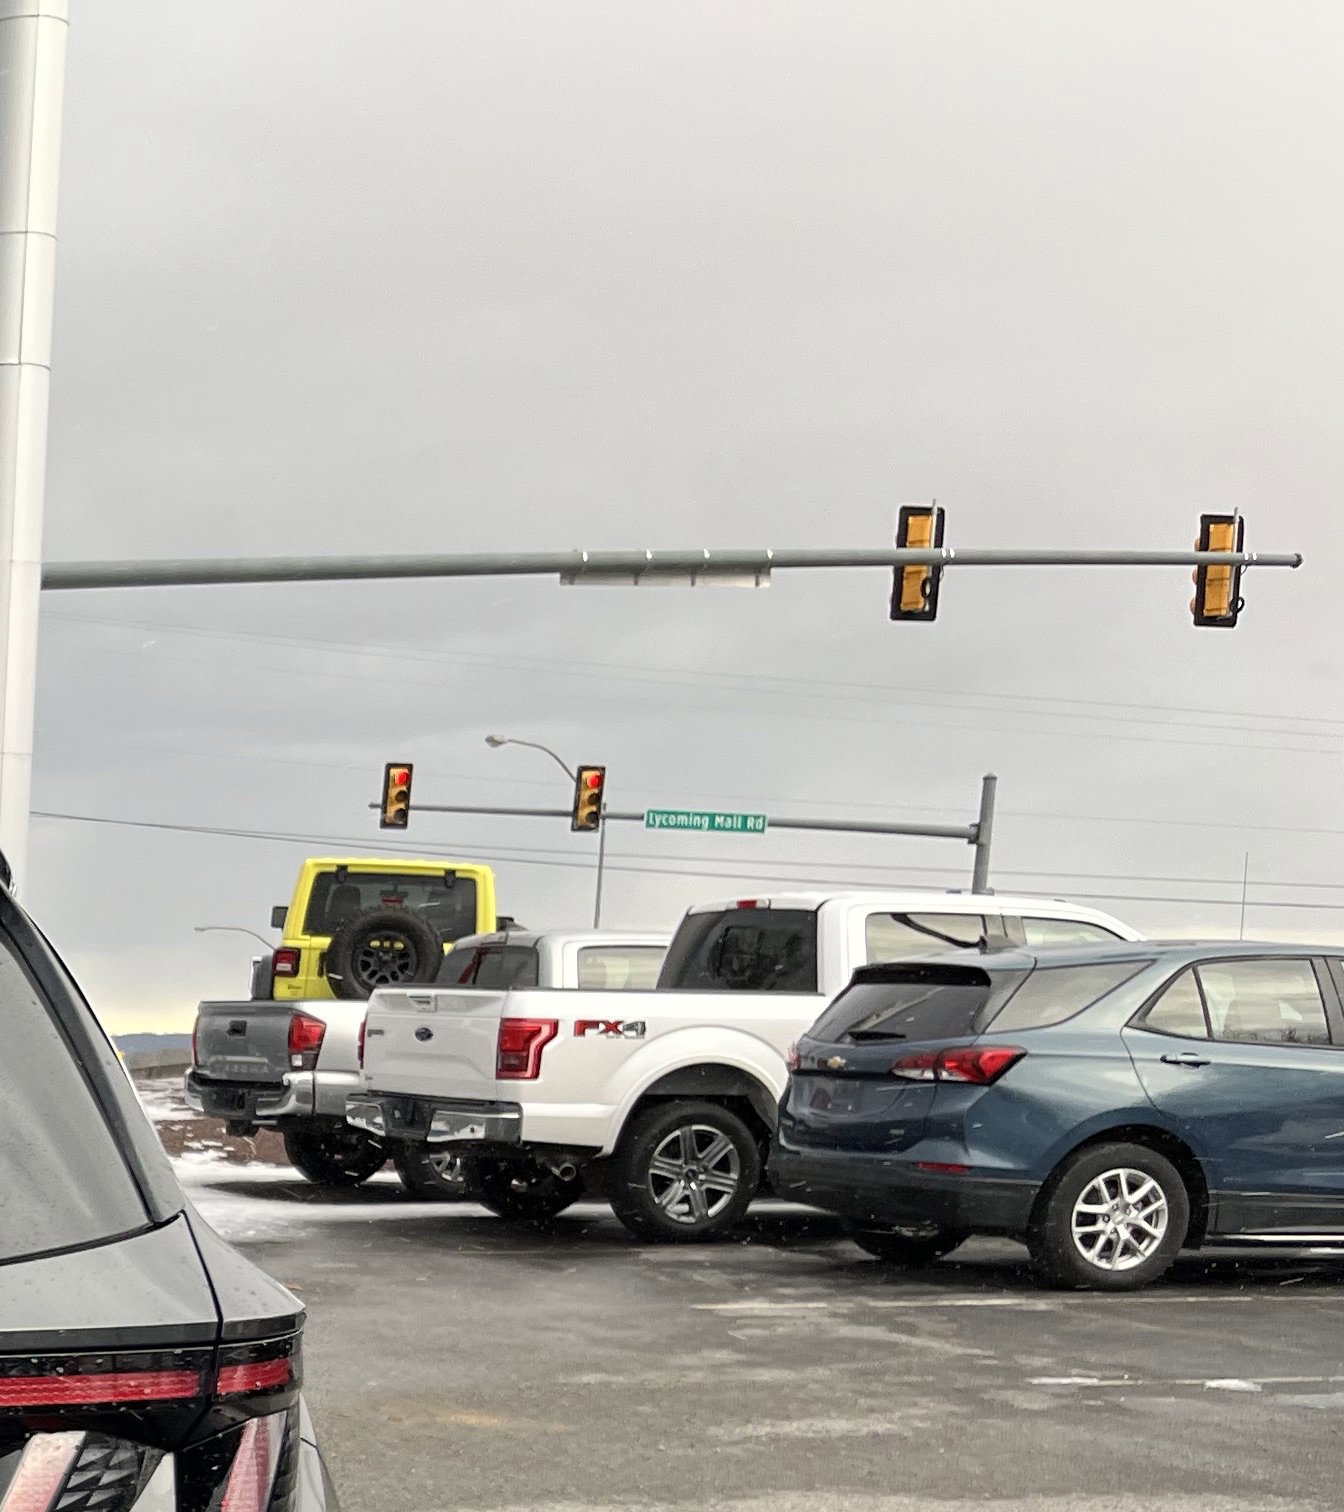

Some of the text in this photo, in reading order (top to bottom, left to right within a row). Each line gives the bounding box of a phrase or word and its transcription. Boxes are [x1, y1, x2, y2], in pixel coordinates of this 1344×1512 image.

[648, 811, 764, 831] Lycoming Mall Rd
[573, 1019, 646, 1039] FX4
